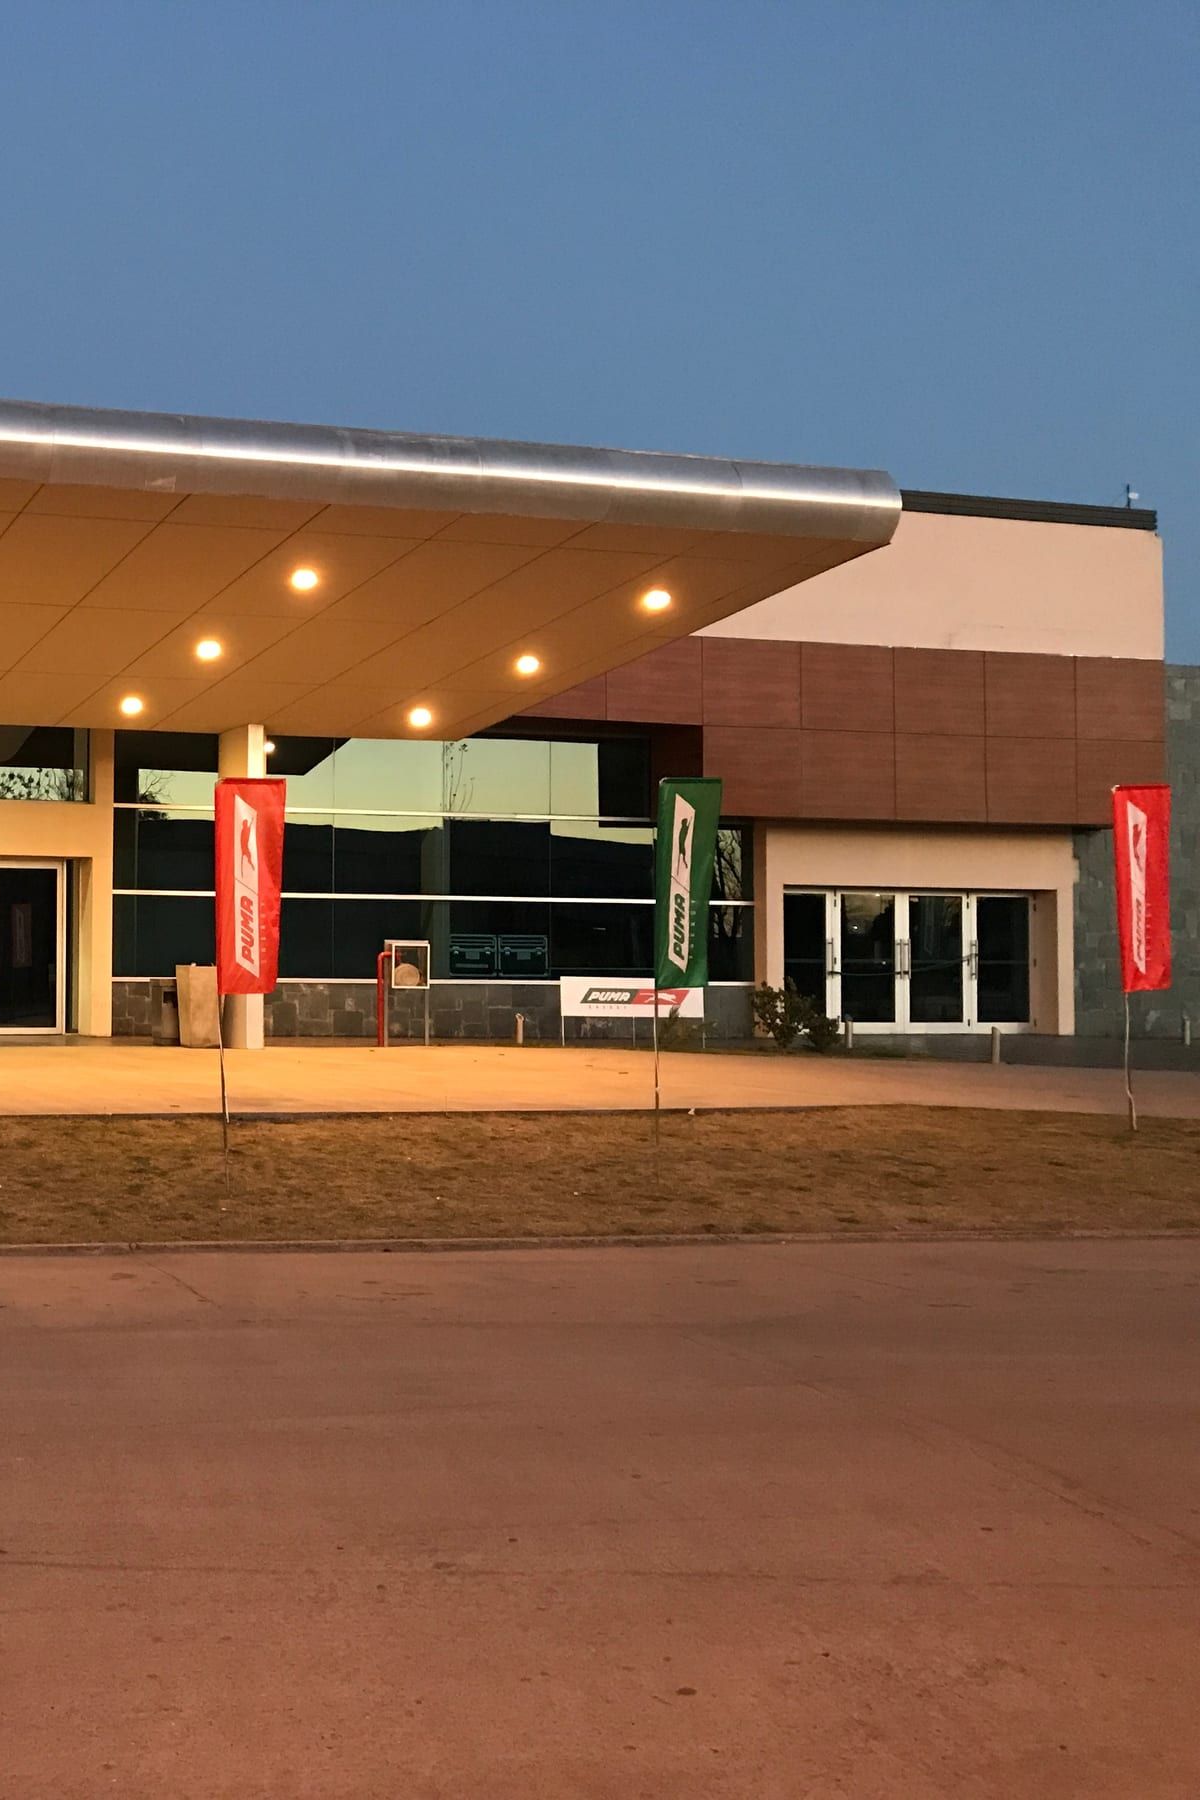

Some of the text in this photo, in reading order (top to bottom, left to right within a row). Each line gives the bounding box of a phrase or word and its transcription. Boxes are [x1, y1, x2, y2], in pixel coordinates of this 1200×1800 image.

[240, 895, 255, 965] PUMA
[673, 893, 686, 961] PUMA
[587, 991, 631, 1002] PUMA
